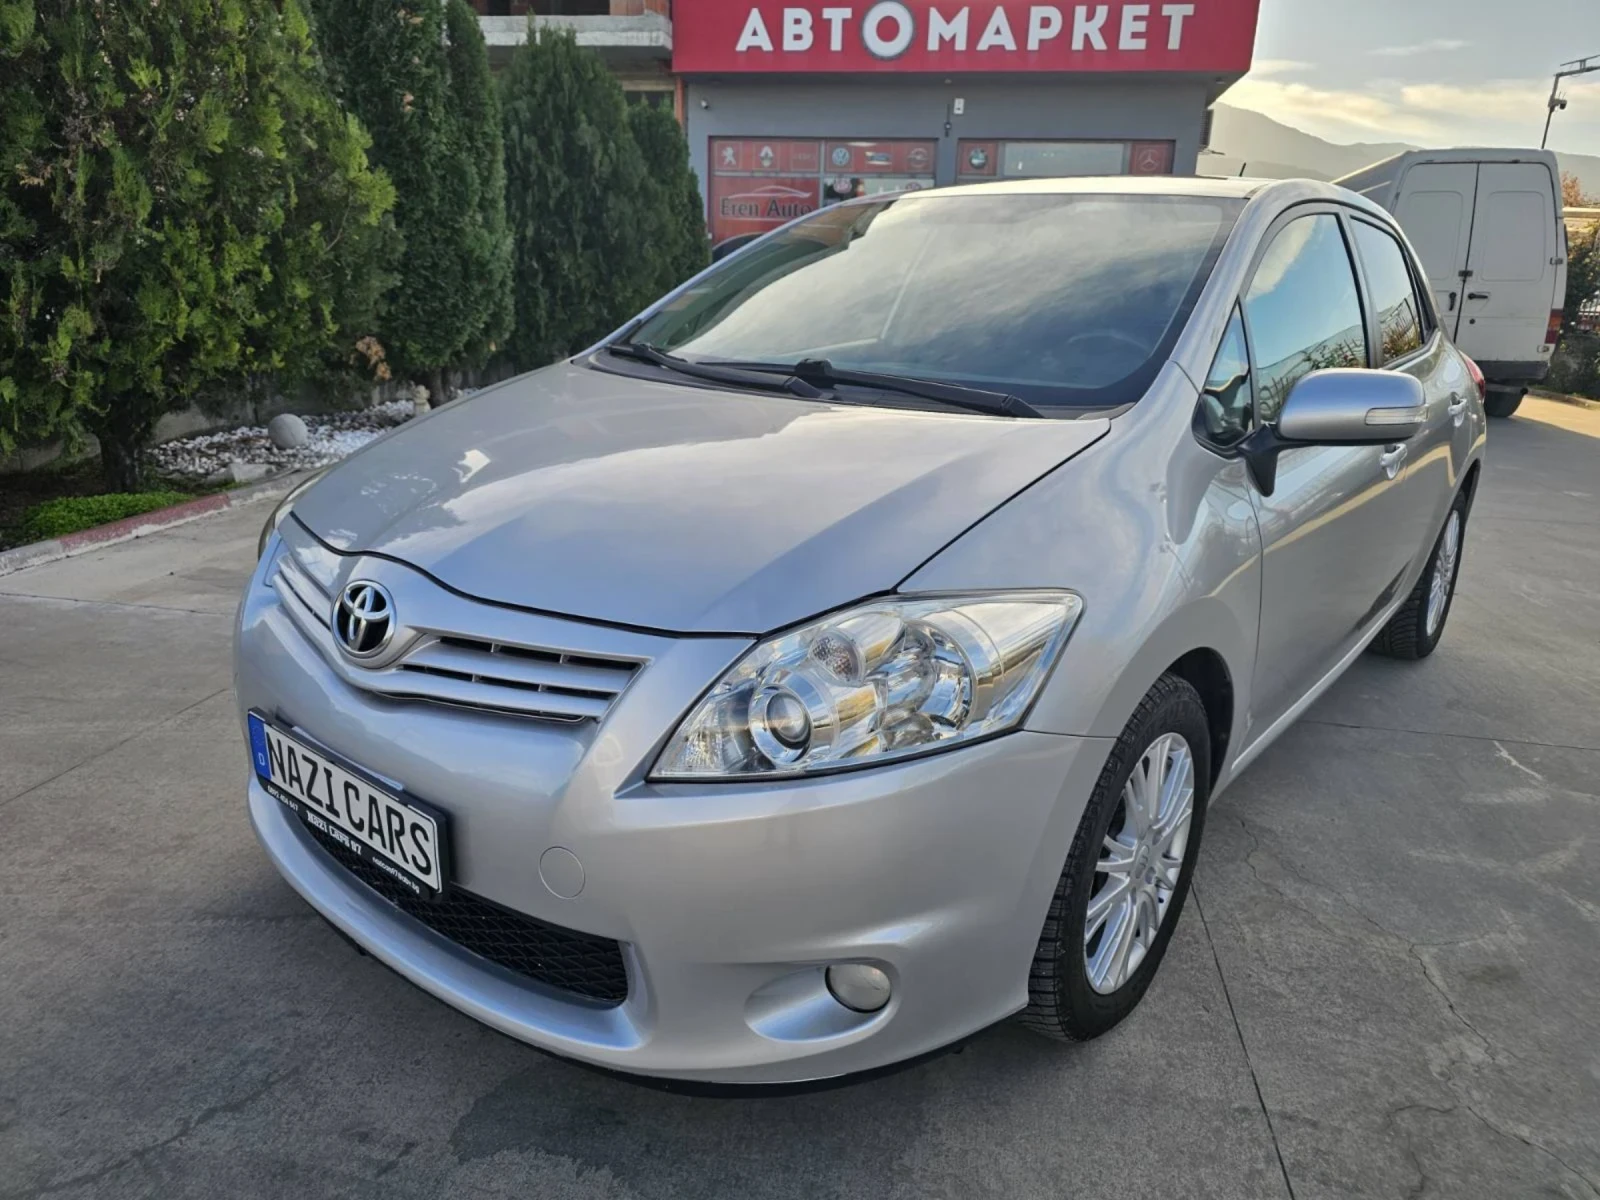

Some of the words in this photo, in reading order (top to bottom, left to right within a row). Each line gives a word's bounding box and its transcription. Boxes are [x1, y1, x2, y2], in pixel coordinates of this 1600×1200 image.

[735, 1, 1194, 56] АВТОМАРКЕТ
[721, 198, 759, 216] Eren
[766, 199, 812, 217] Auto
[258, 752, 266, 767] D
